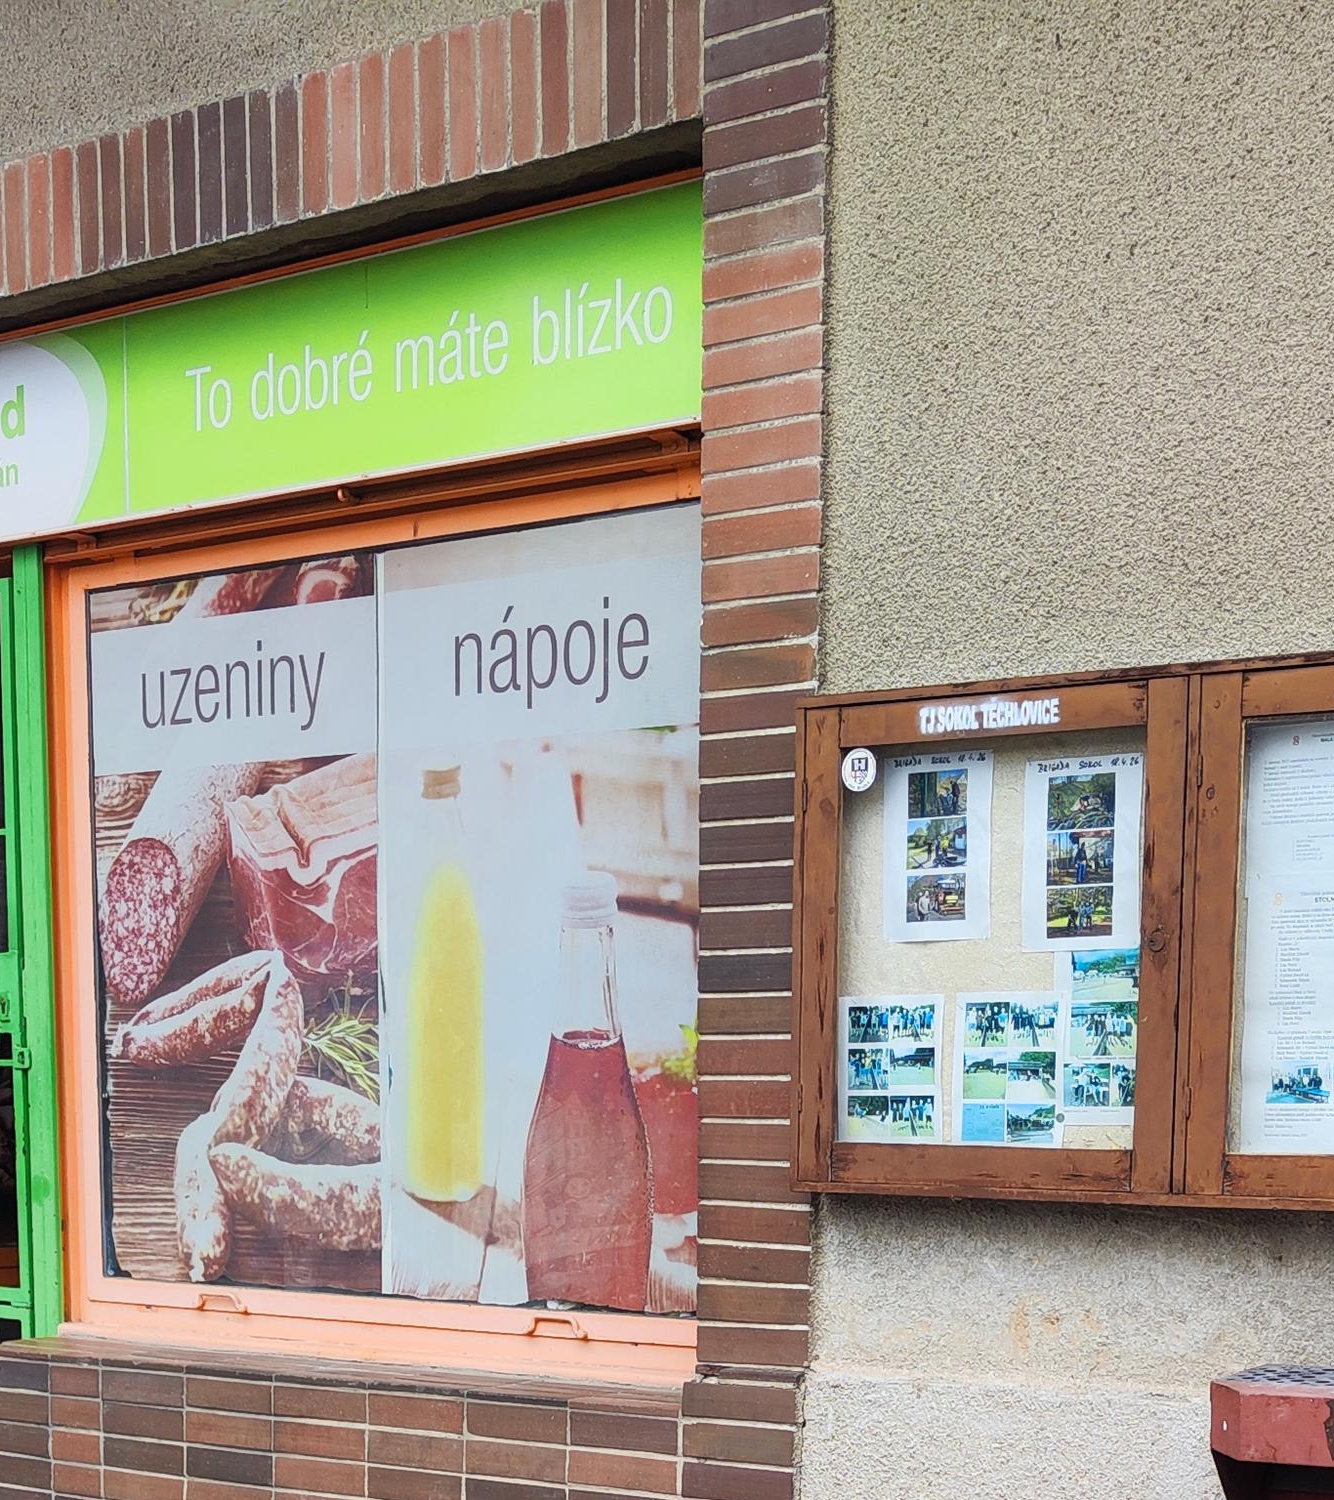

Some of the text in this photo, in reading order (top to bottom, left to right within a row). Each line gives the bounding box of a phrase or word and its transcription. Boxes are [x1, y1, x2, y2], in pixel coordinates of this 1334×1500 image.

[185, 278, 673, 432] To dobré máte blízko
[140, 639, 326, 731] uzeniny
[452, 595, 651, 709] nápoje
[919, 706, 935, 734] TJ
[935, 704, 979, 732] SOKOL
